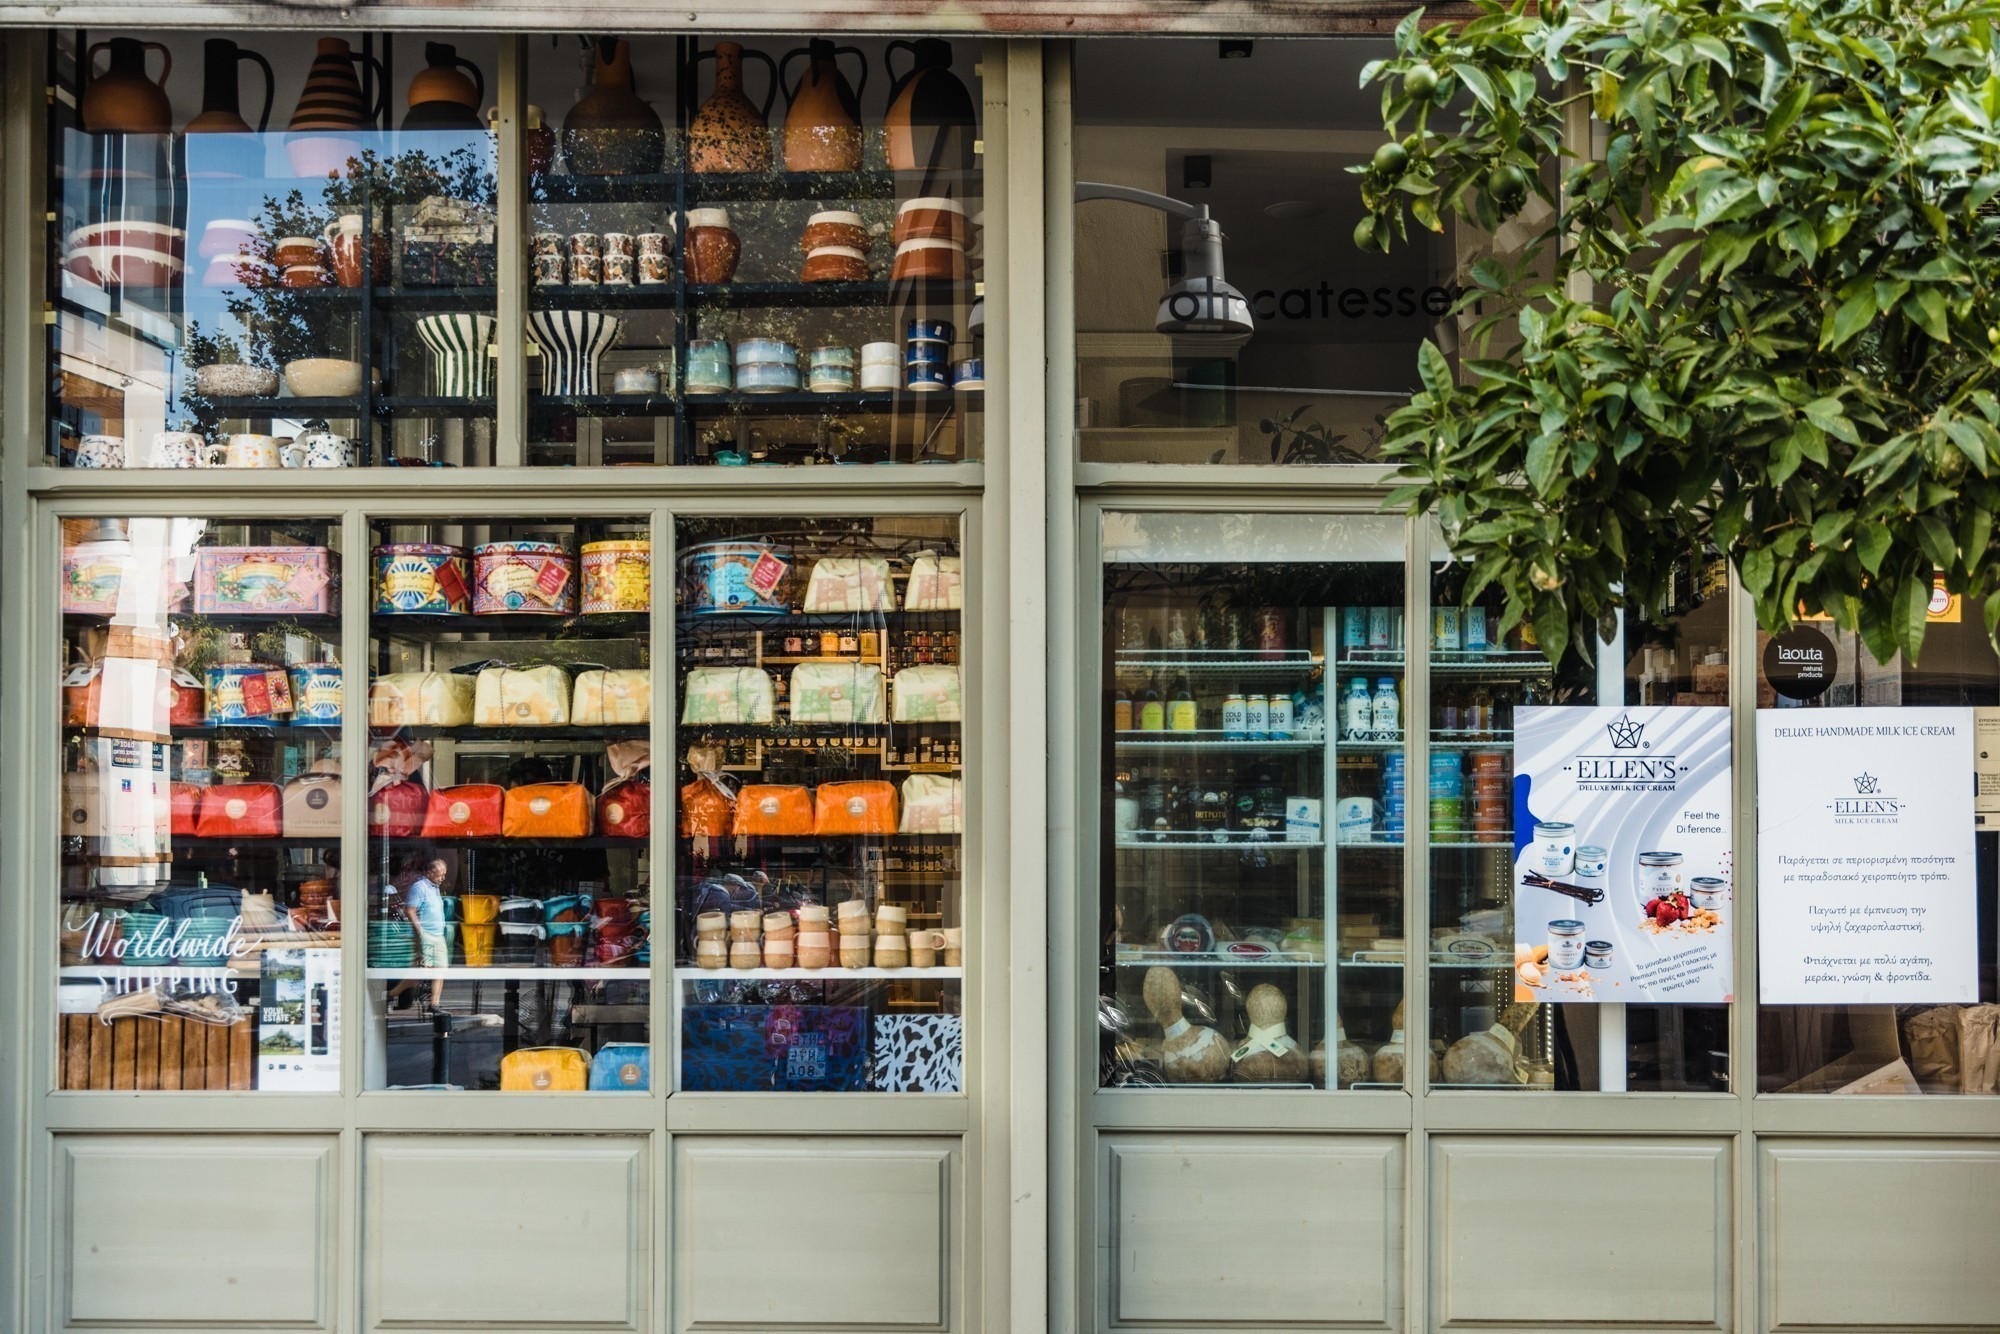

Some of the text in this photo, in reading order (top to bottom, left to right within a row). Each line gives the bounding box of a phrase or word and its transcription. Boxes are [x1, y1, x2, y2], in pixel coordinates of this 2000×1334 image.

[1778, 645, 1823, 660] laouta
[1775, 727, 1954, 737] DELUXE HANDMADE MILK ICE CREAM
[1579, 761, 1676, 779] ELLEN'S
[1836, 801, 1897, 812] ELLEN'S
[1779, 856, 1828, 866] Παράγεται
[1847, 855, 1907, 866] περιορισμένη
[1911, 855, 1954, 865] ποσότητα
[1784, 871, 1949, 883] με παραδοσιακό χειροποίητο τρόπο.
[1809, 906, 1926, 916] Παγωτό με έμπνευση την
[1811, 921, 1924, 933] υψηλή ζαχαροπλαστική.
[67, 911, 264, 958] Worldwide
[1644, 956, 1671, 969] μοναδικό
[1804, 954, 1932, 967] Φτιάχνεται με πολύ αγάπη,
[96, 968, 239, 994] SHIPPING
[1630, 971, 1657, 982] Premium
[1805, 973, 1839, 983] μεράκι,
[1843, 973, 1870, 983] γνώση
[1886, 971, 1931, 983] φροντίδα.
[263, 1007, 284, 1015] VOLVI
[263, 1015, 290, 1023] ESTATE
